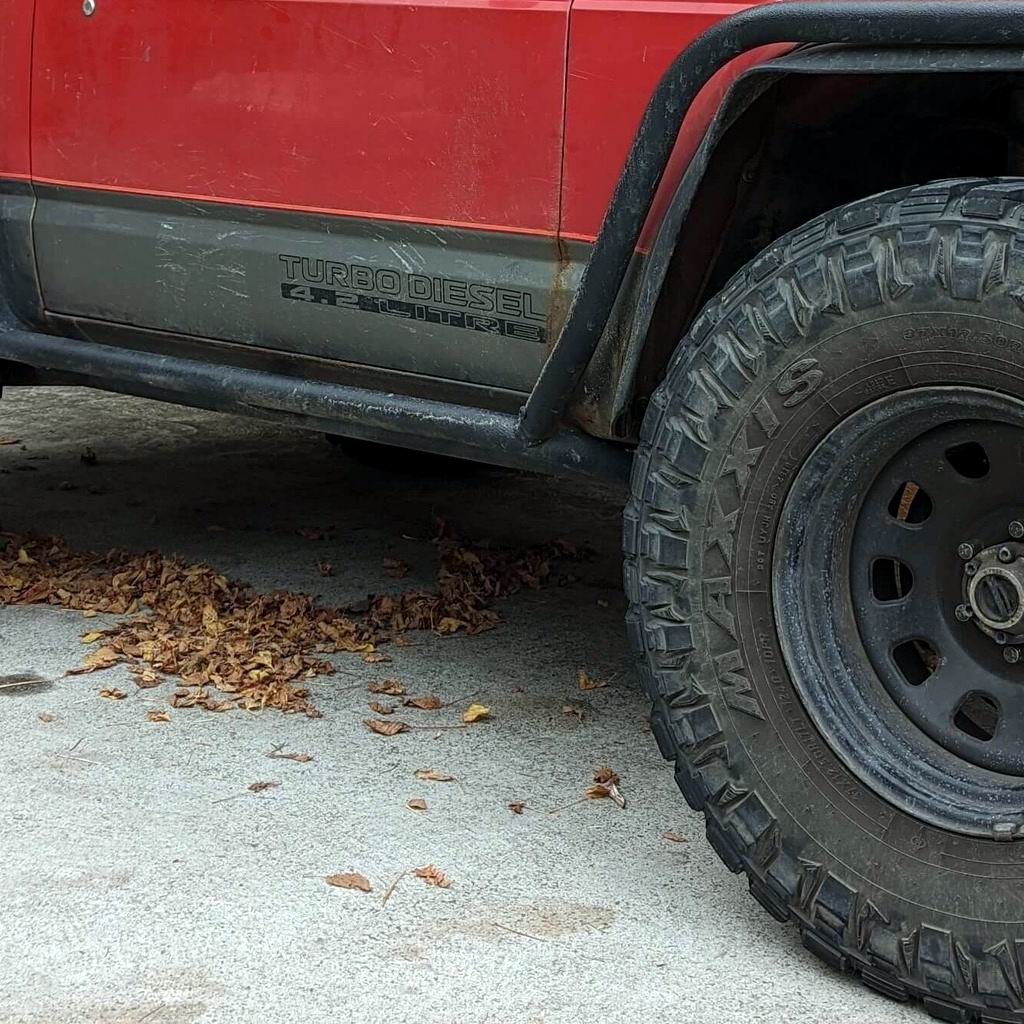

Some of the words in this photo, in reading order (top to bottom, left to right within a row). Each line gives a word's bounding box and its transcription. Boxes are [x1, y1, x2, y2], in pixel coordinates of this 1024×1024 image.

[279, 253, 402, 296] TURBO
[407, 274, 551, 323] DIESEL
[287, 284, 362, 311] 4.2
[374, 297, 546, 343] LITRE
[701, 357, 824, 722] MAXXIS
